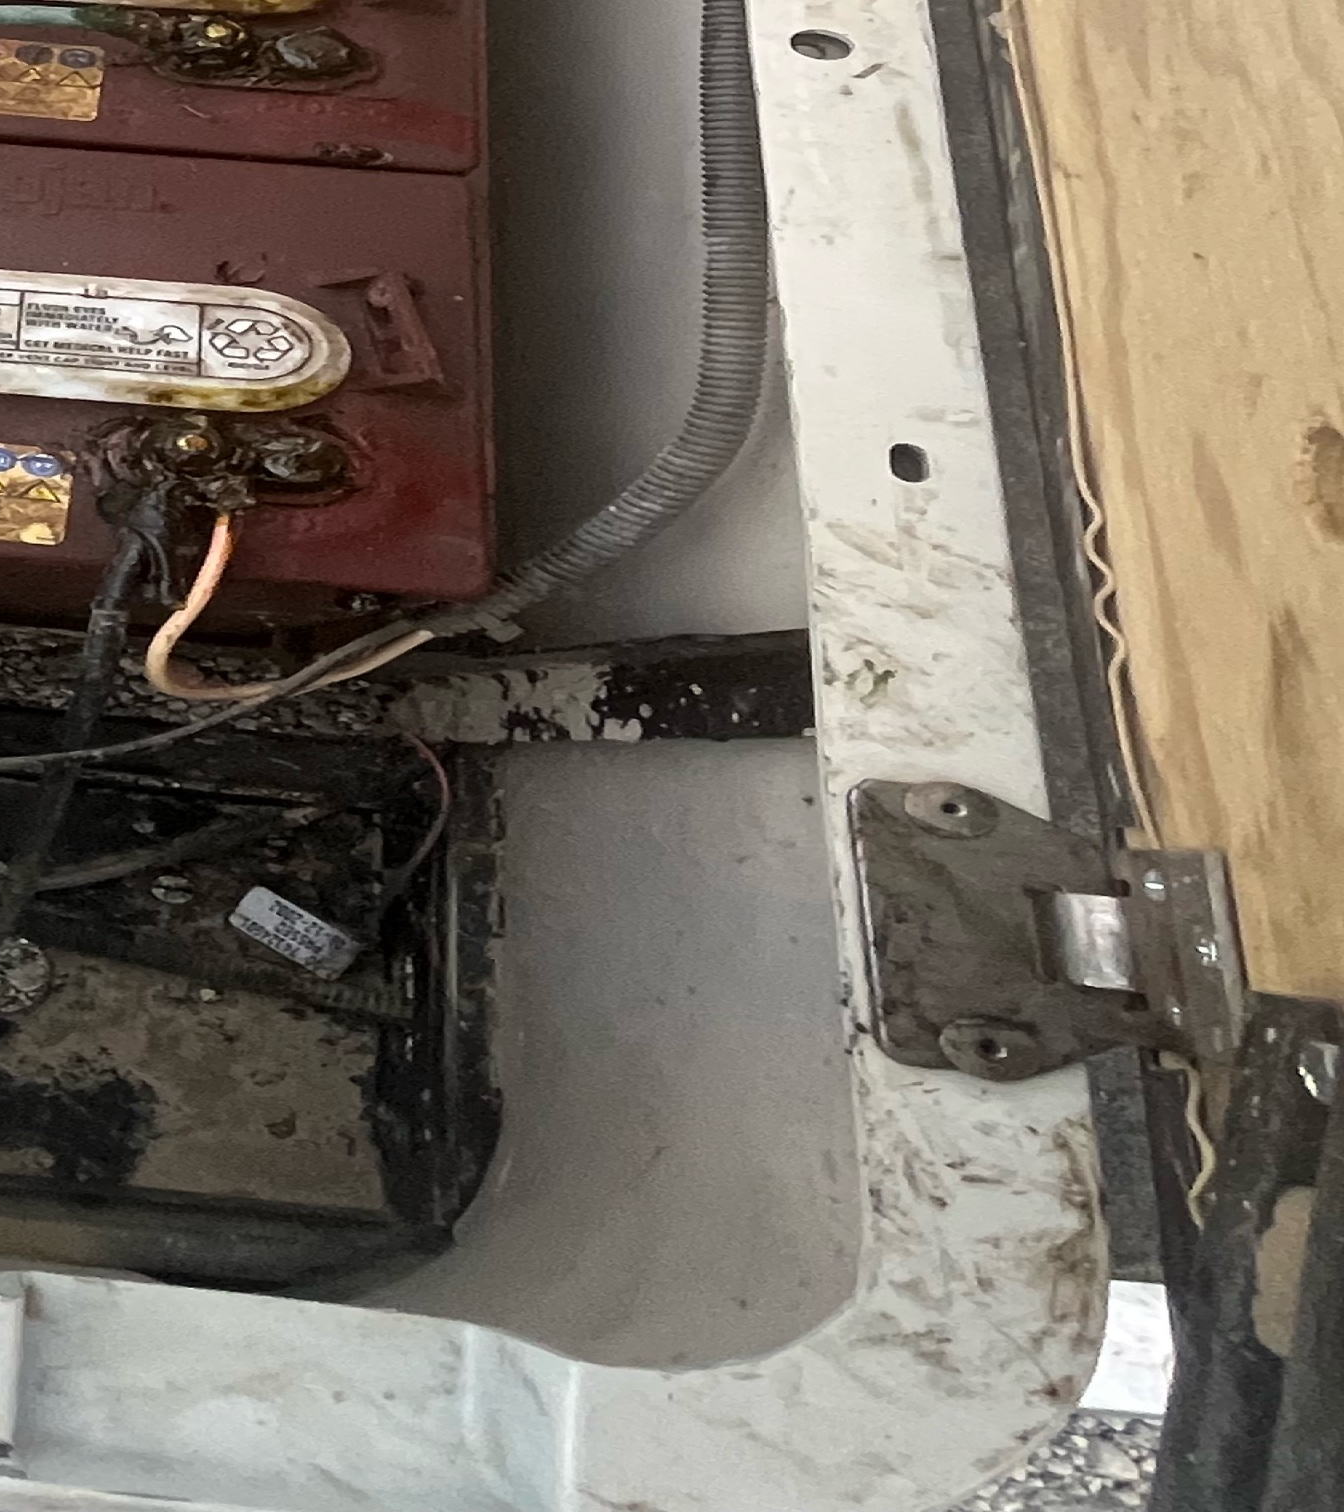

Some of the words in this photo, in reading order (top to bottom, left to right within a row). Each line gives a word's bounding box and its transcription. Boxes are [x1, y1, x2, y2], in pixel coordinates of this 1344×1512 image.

[24, 339, 49, 348] GET
[53, 341, 114, 353] MEDICAL
[118, 345, 153, 356] HELP
[156, 349, 189, 359] FAST
